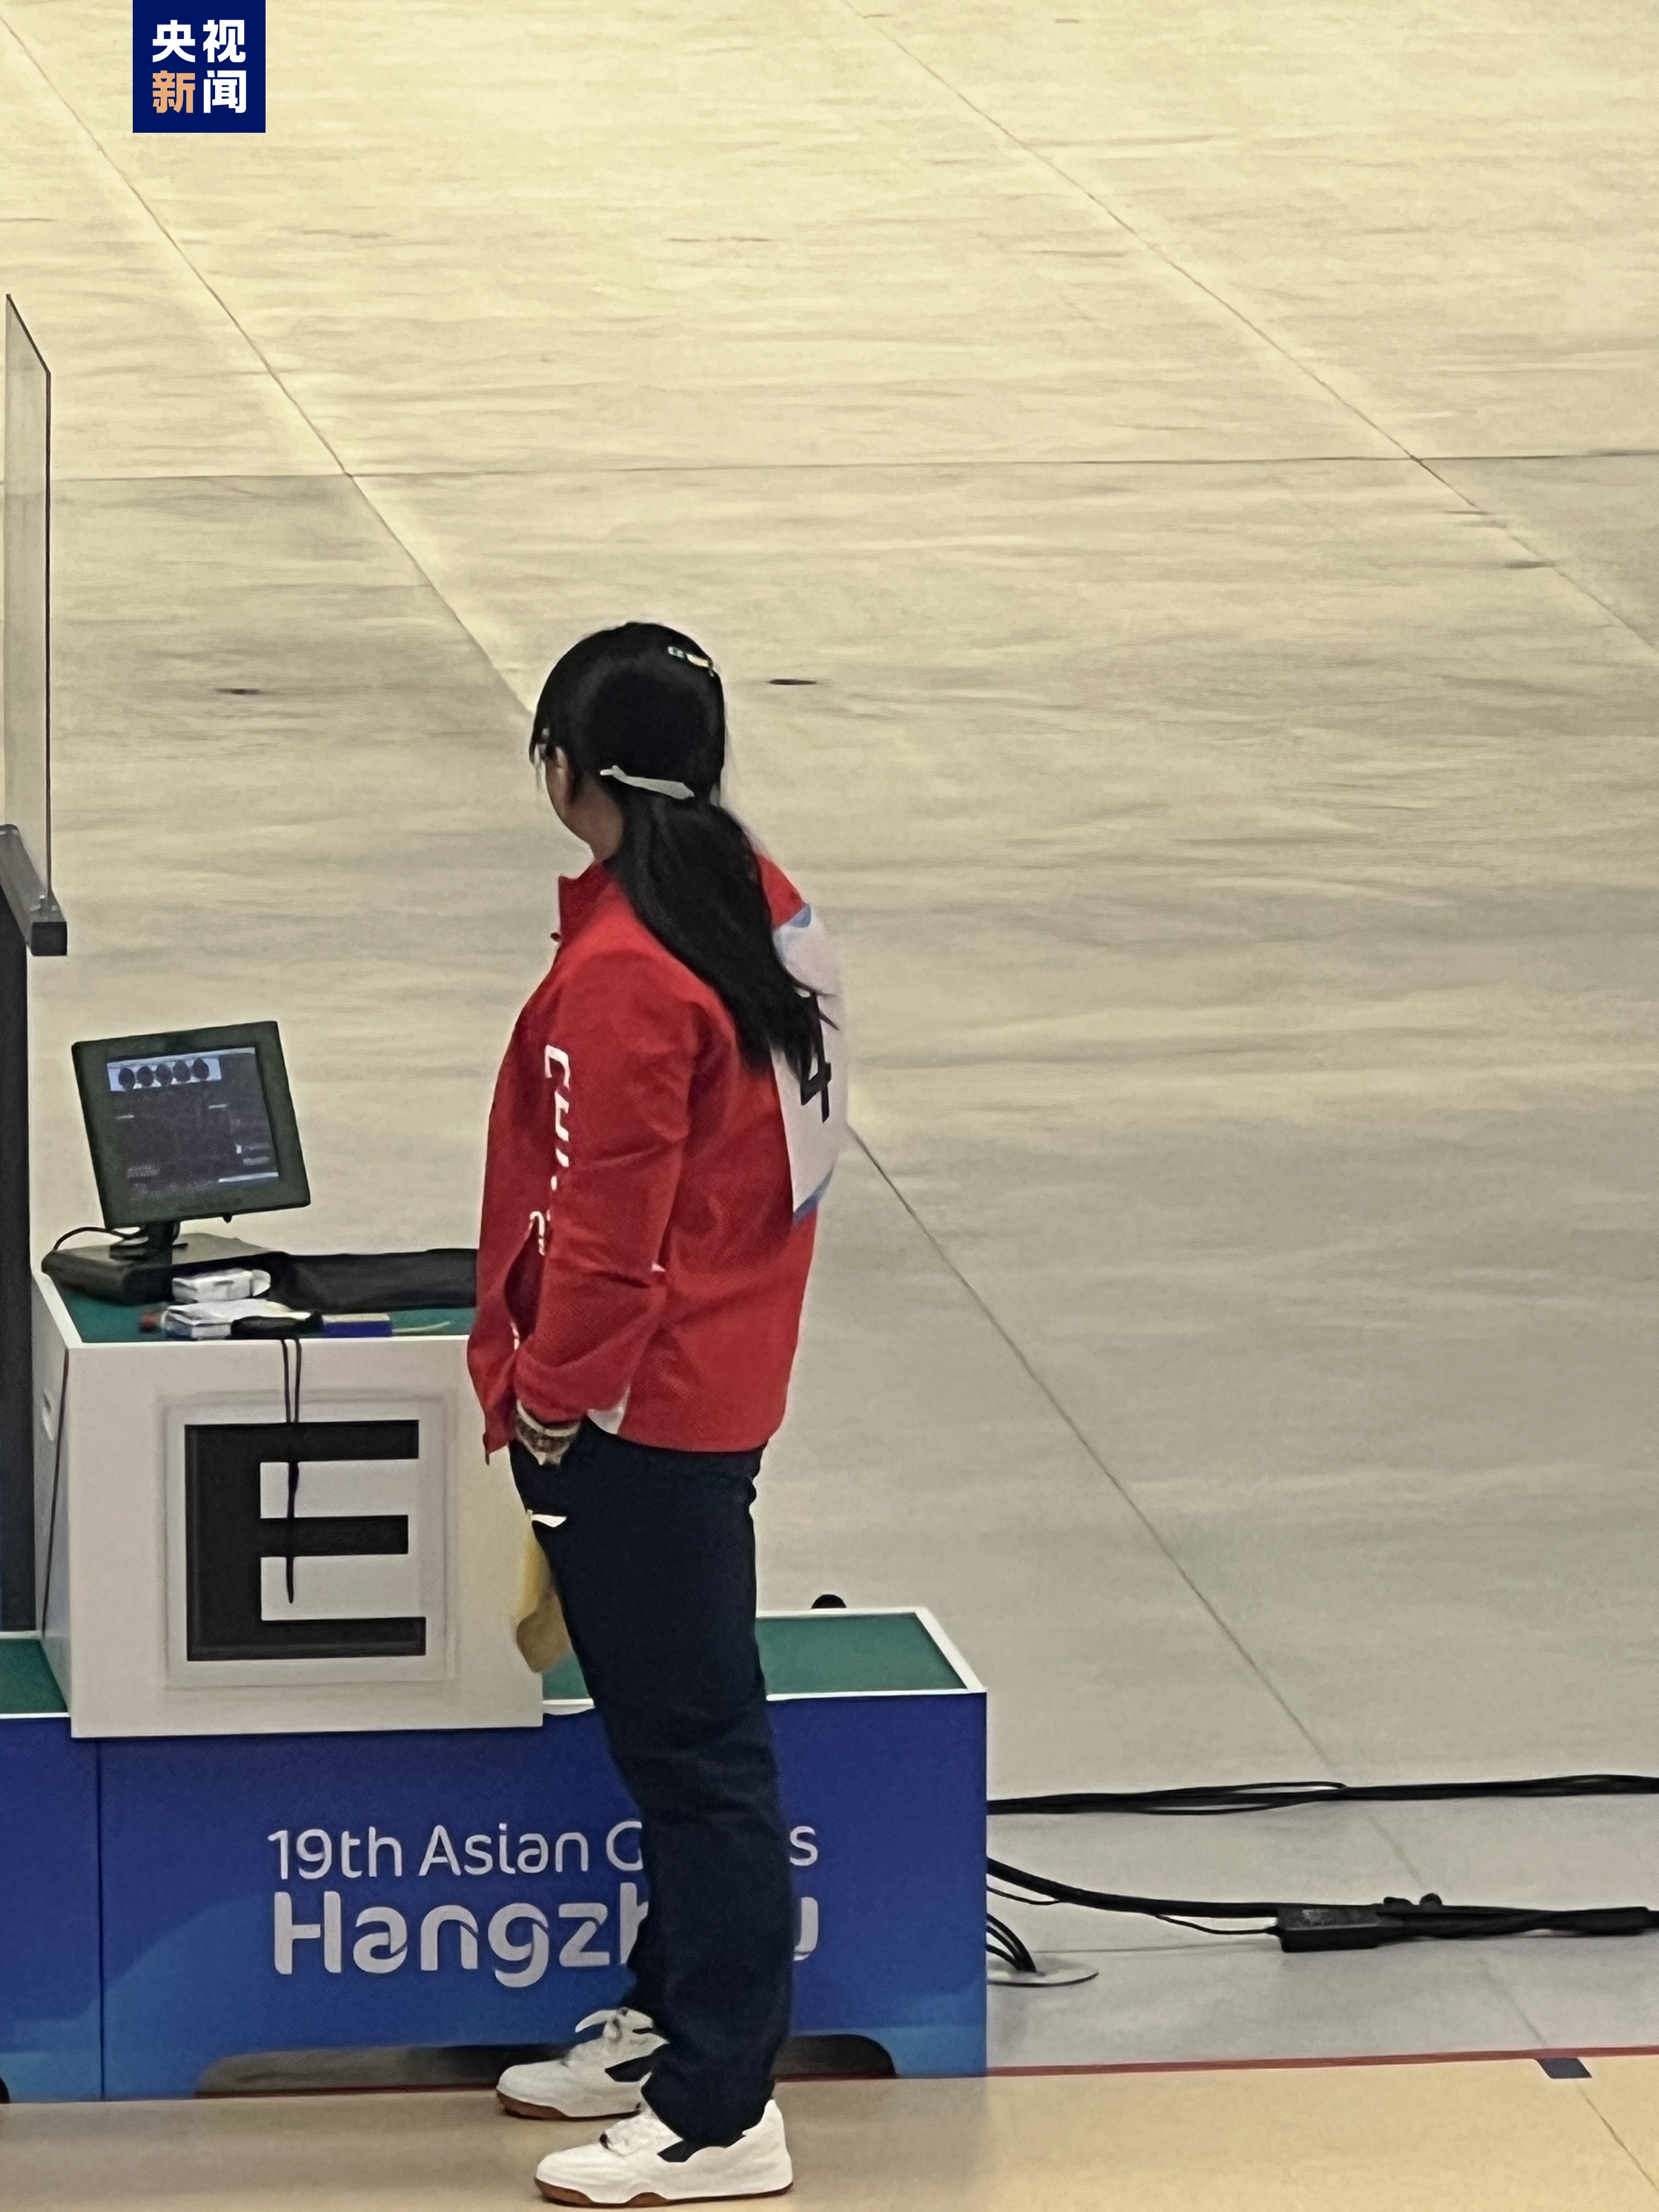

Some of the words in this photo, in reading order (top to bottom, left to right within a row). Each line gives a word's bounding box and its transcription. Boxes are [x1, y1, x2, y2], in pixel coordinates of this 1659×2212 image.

[185, 1420, 426, 1662] E
[267, 1826, 402, 1880] 19th
[418, 1823, 589, 1876] Asian
